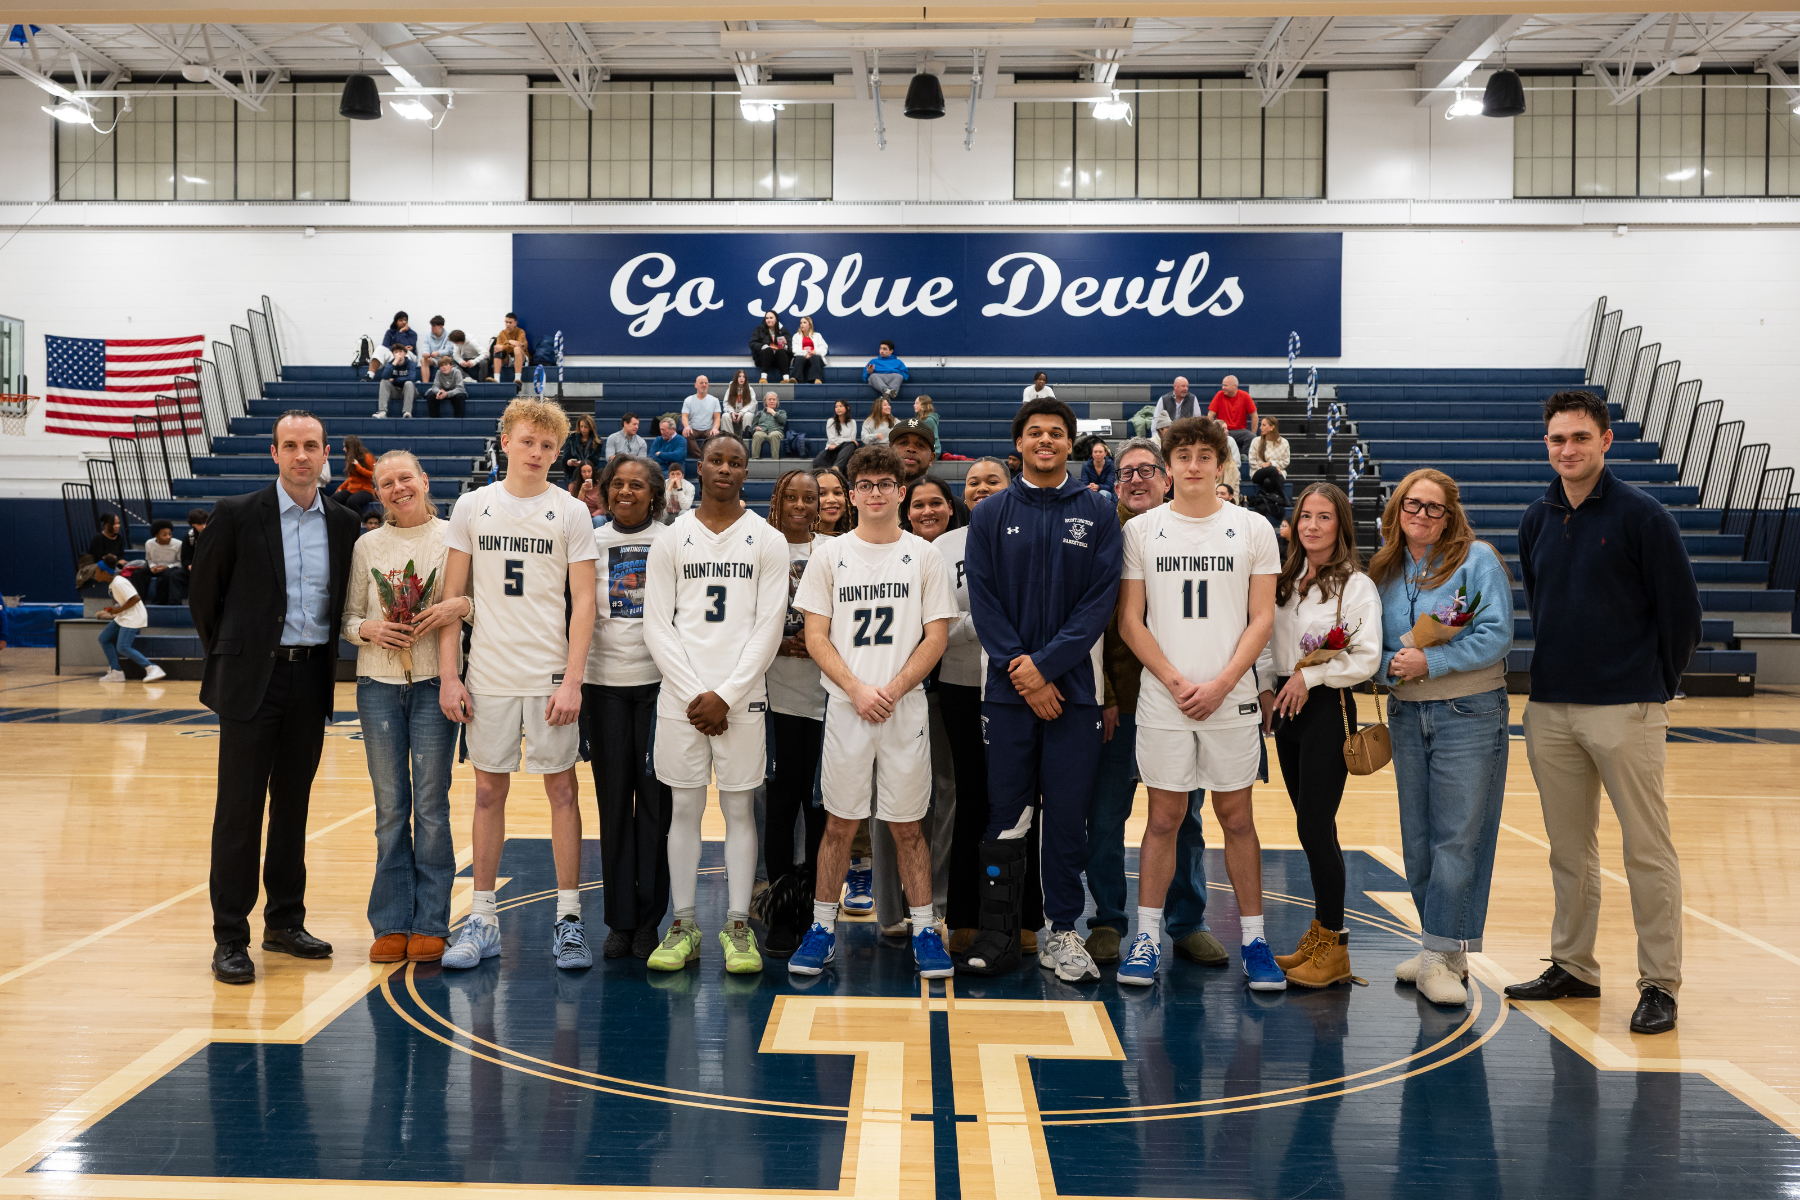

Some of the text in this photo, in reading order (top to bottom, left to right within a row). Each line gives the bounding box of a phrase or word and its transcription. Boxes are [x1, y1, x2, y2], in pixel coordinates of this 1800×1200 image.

[609, 251, 1244, 338] Go Blue Devils
[478, 535, 554, 555] HUNTINGTON
[503, 559, 525, 597] 5
[683, 562, 754, 580] HUNTINGTON
[1156, 556, 1234, 573] HUNTINGTON
[704, 585, 727, 623] 3
[839, 582, 909, 603] HUNTINGTON
[1181, 579, 1209, 619] 11
[853, 606, 895, 648] 22
